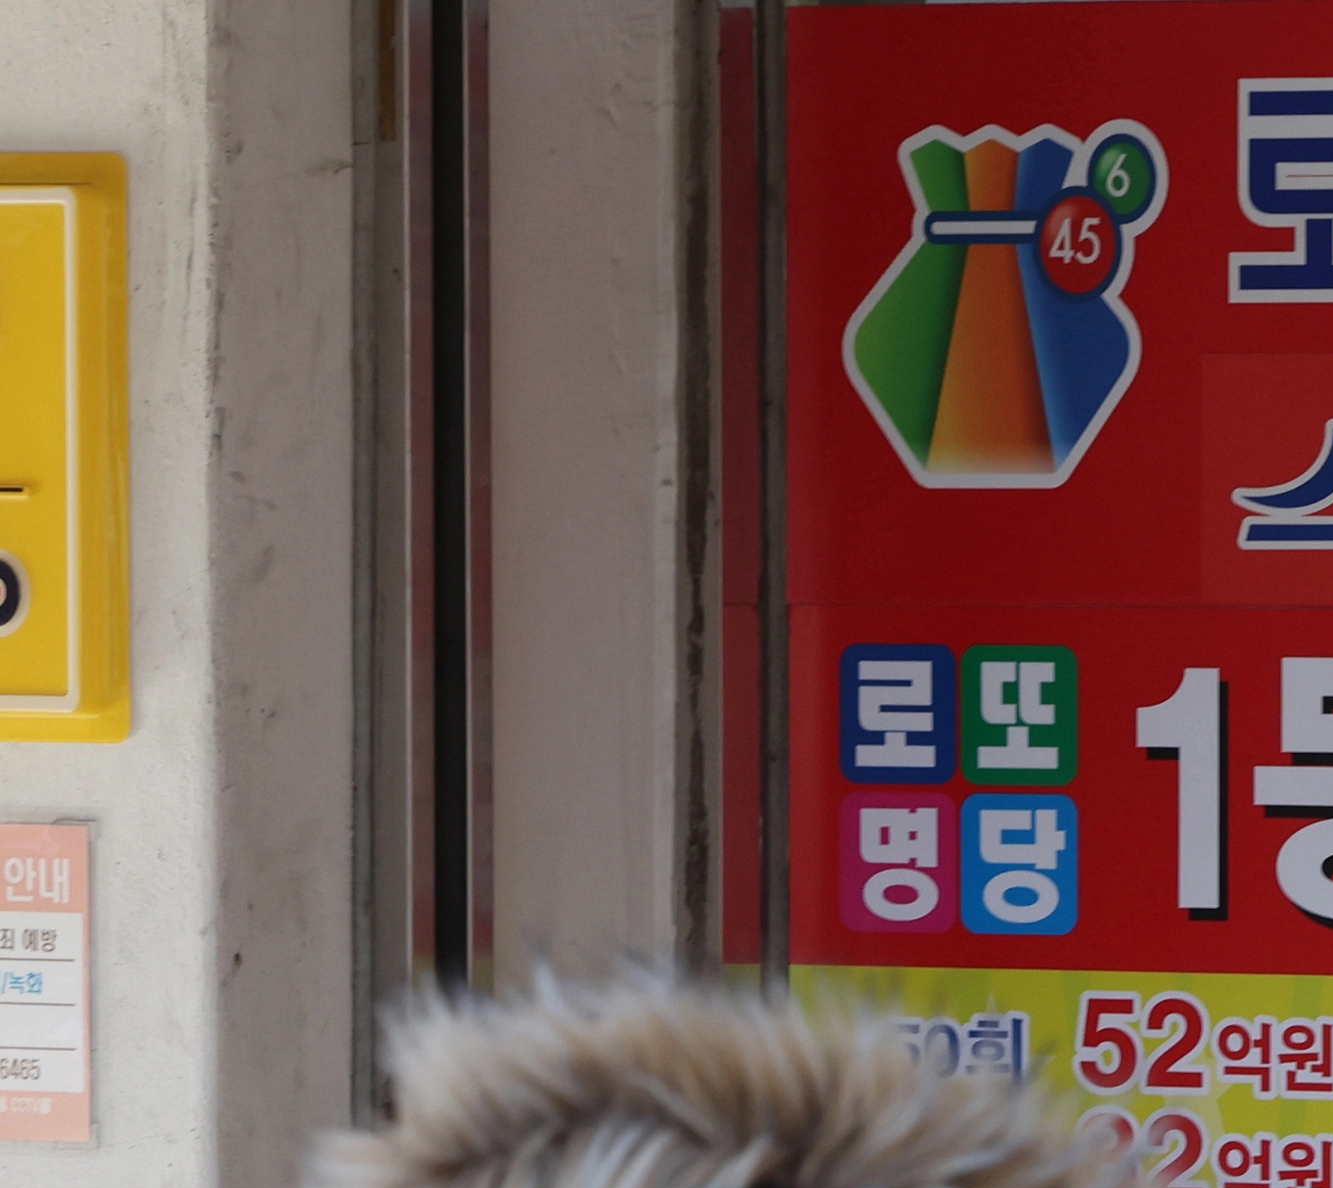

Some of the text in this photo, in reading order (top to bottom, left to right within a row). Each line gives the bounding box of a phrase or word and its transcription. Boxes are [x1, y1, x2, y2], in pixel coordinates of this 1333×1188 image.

[1106, 153, 1131, 199] 6
[1049, 217, 1101, 265] 45
[4, 857, 71, 904] 안내
[21, 927, 58, 953] 예방
